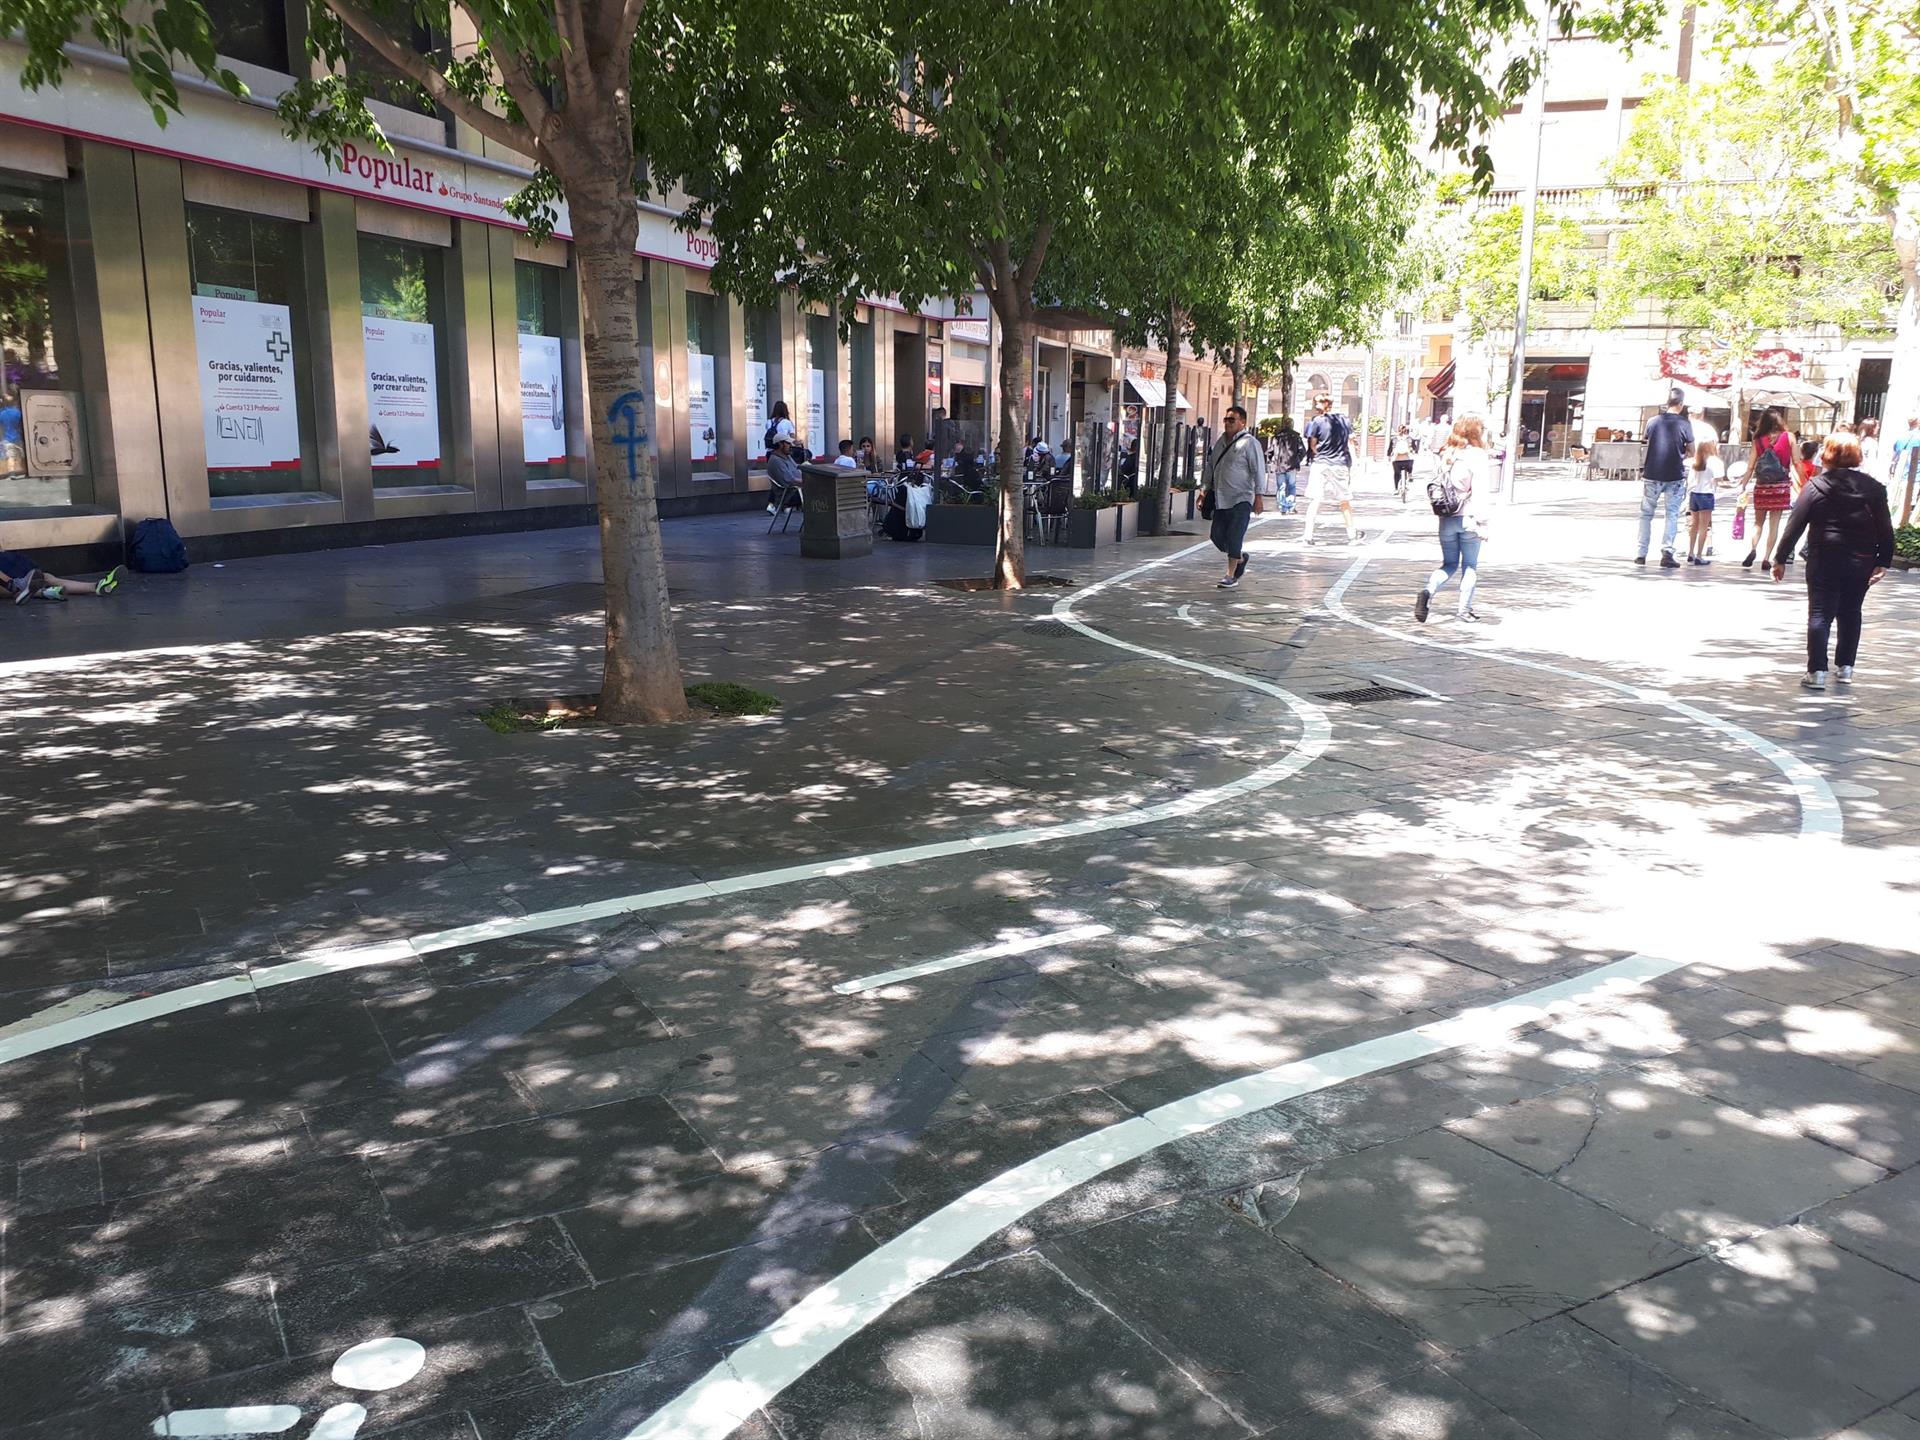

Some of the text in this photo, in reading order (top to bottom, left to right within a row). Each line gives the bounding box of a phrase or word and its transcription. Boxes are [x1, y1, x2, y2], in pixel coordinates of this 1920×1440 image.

[343, 143, 434, 193] Popular
[450, 186, 504, 209] Grupo Santande
[686, 229, 720, 262] Popu
[200, 307, 226, 318] Popular
[208, 360, 283, 375] Gracias, valientes,
[218, 373, 276, 384] por cuidarnos.
[371, 372, 428, 385] Gracias, valientes,
[373, 383, 427, 393] por crear cultura.
[226, 403, 243, 412] Cuenta
